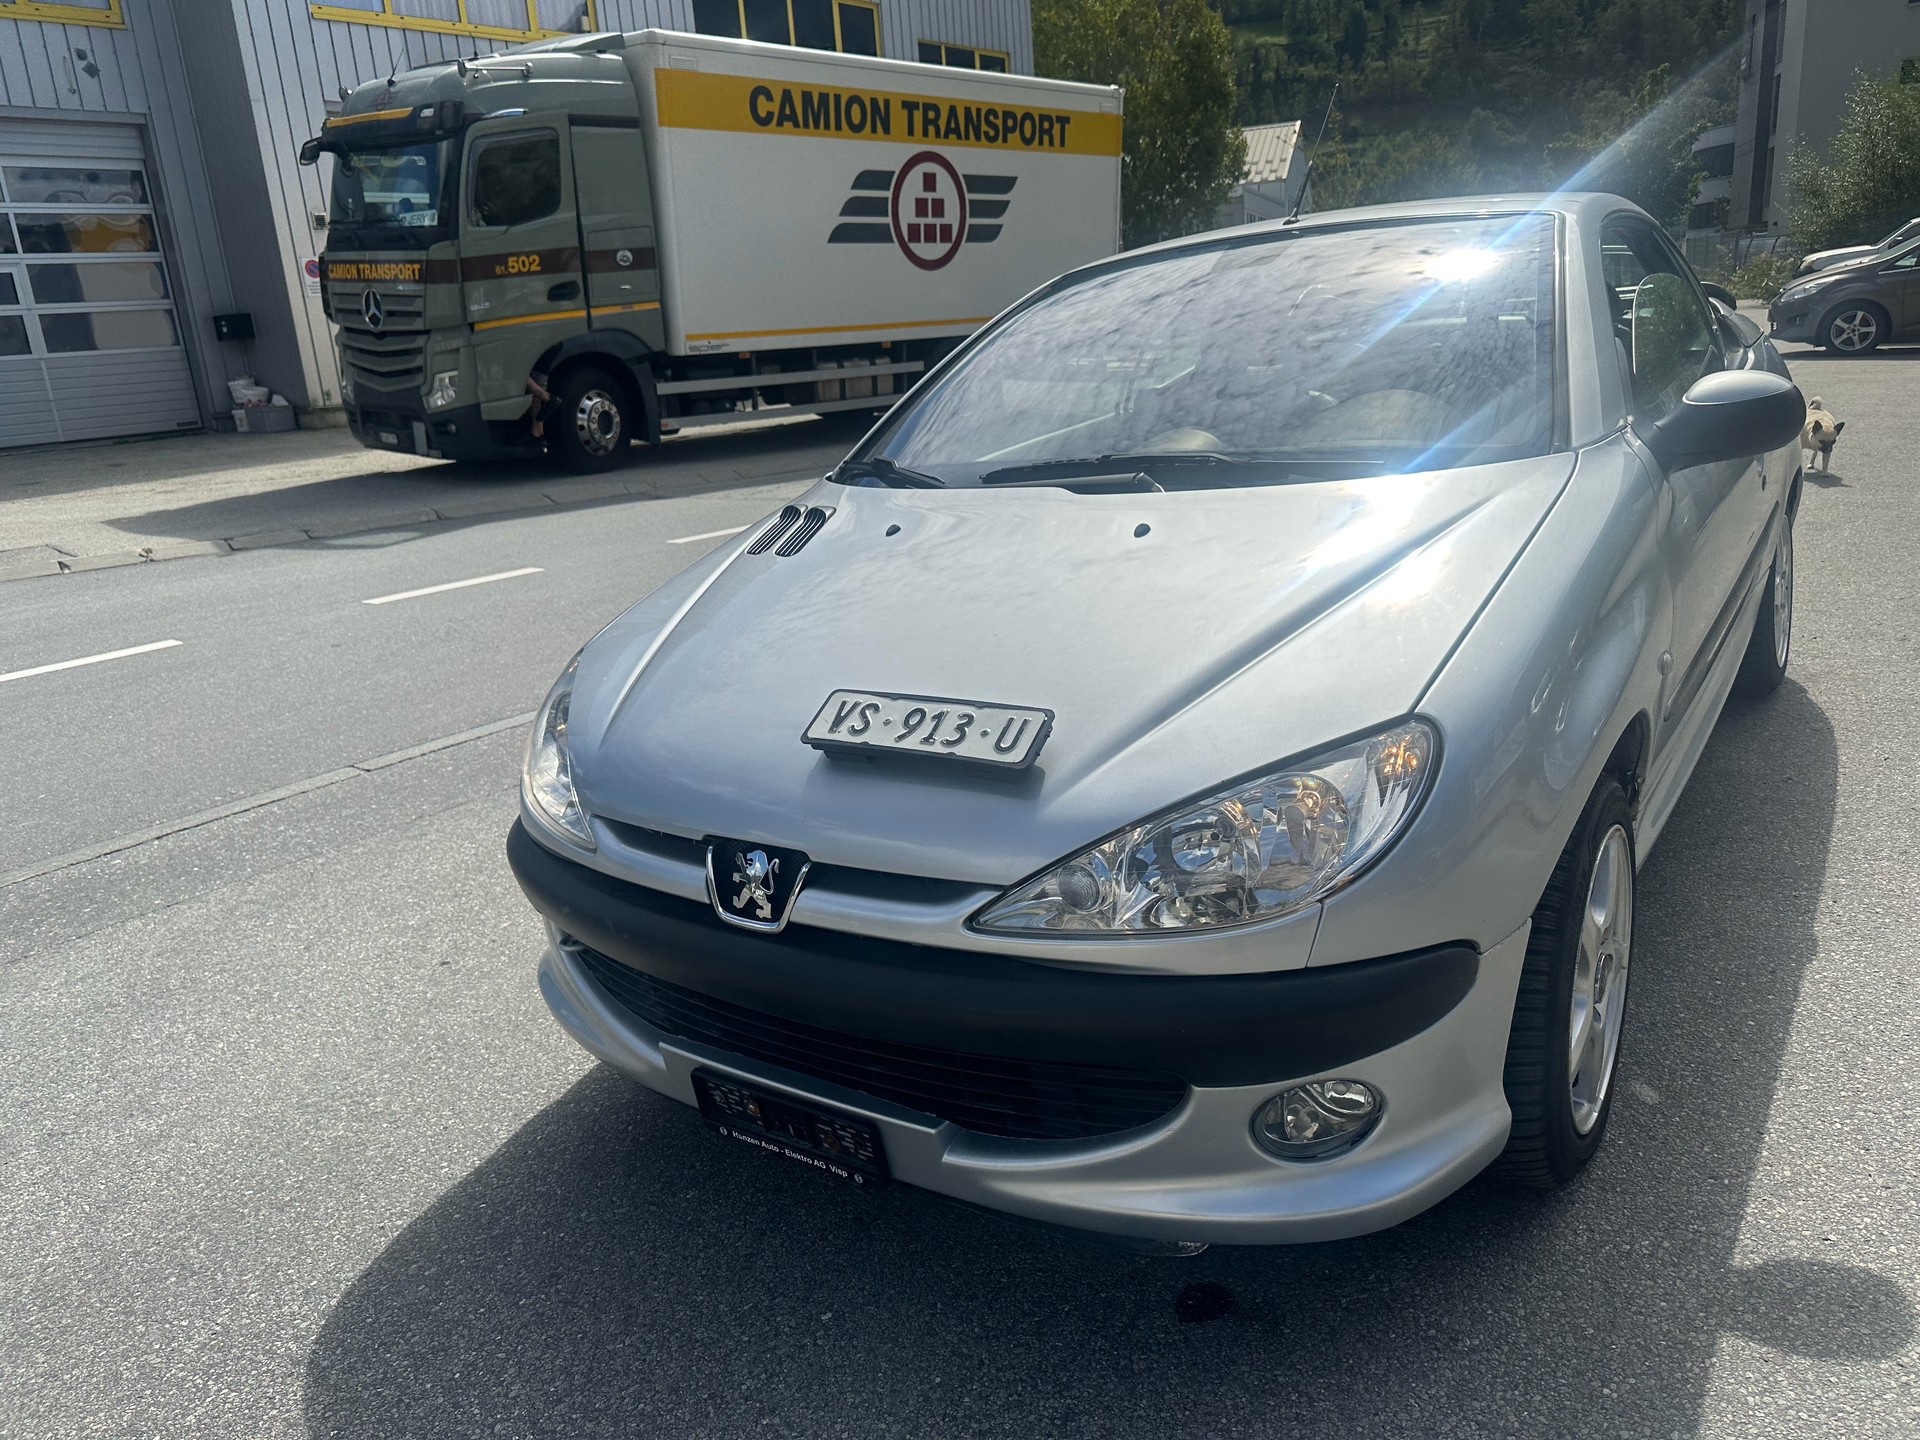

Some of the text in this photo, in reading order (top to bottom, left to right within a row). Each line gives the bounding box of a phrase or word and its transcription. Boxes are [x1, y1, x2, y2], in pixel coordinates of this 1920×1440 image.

[749, 85, 1071, 148] CAMION TRANSPORT
[328, 263, 421, 280] CAMION TRANSPORT
[761, 1141, 779, 1152] Auto
[785, 1148, 812, 1164] Elektro
[814, 1159, 826, 1169] AG
[829, 1164, 848, 1178] Visp
